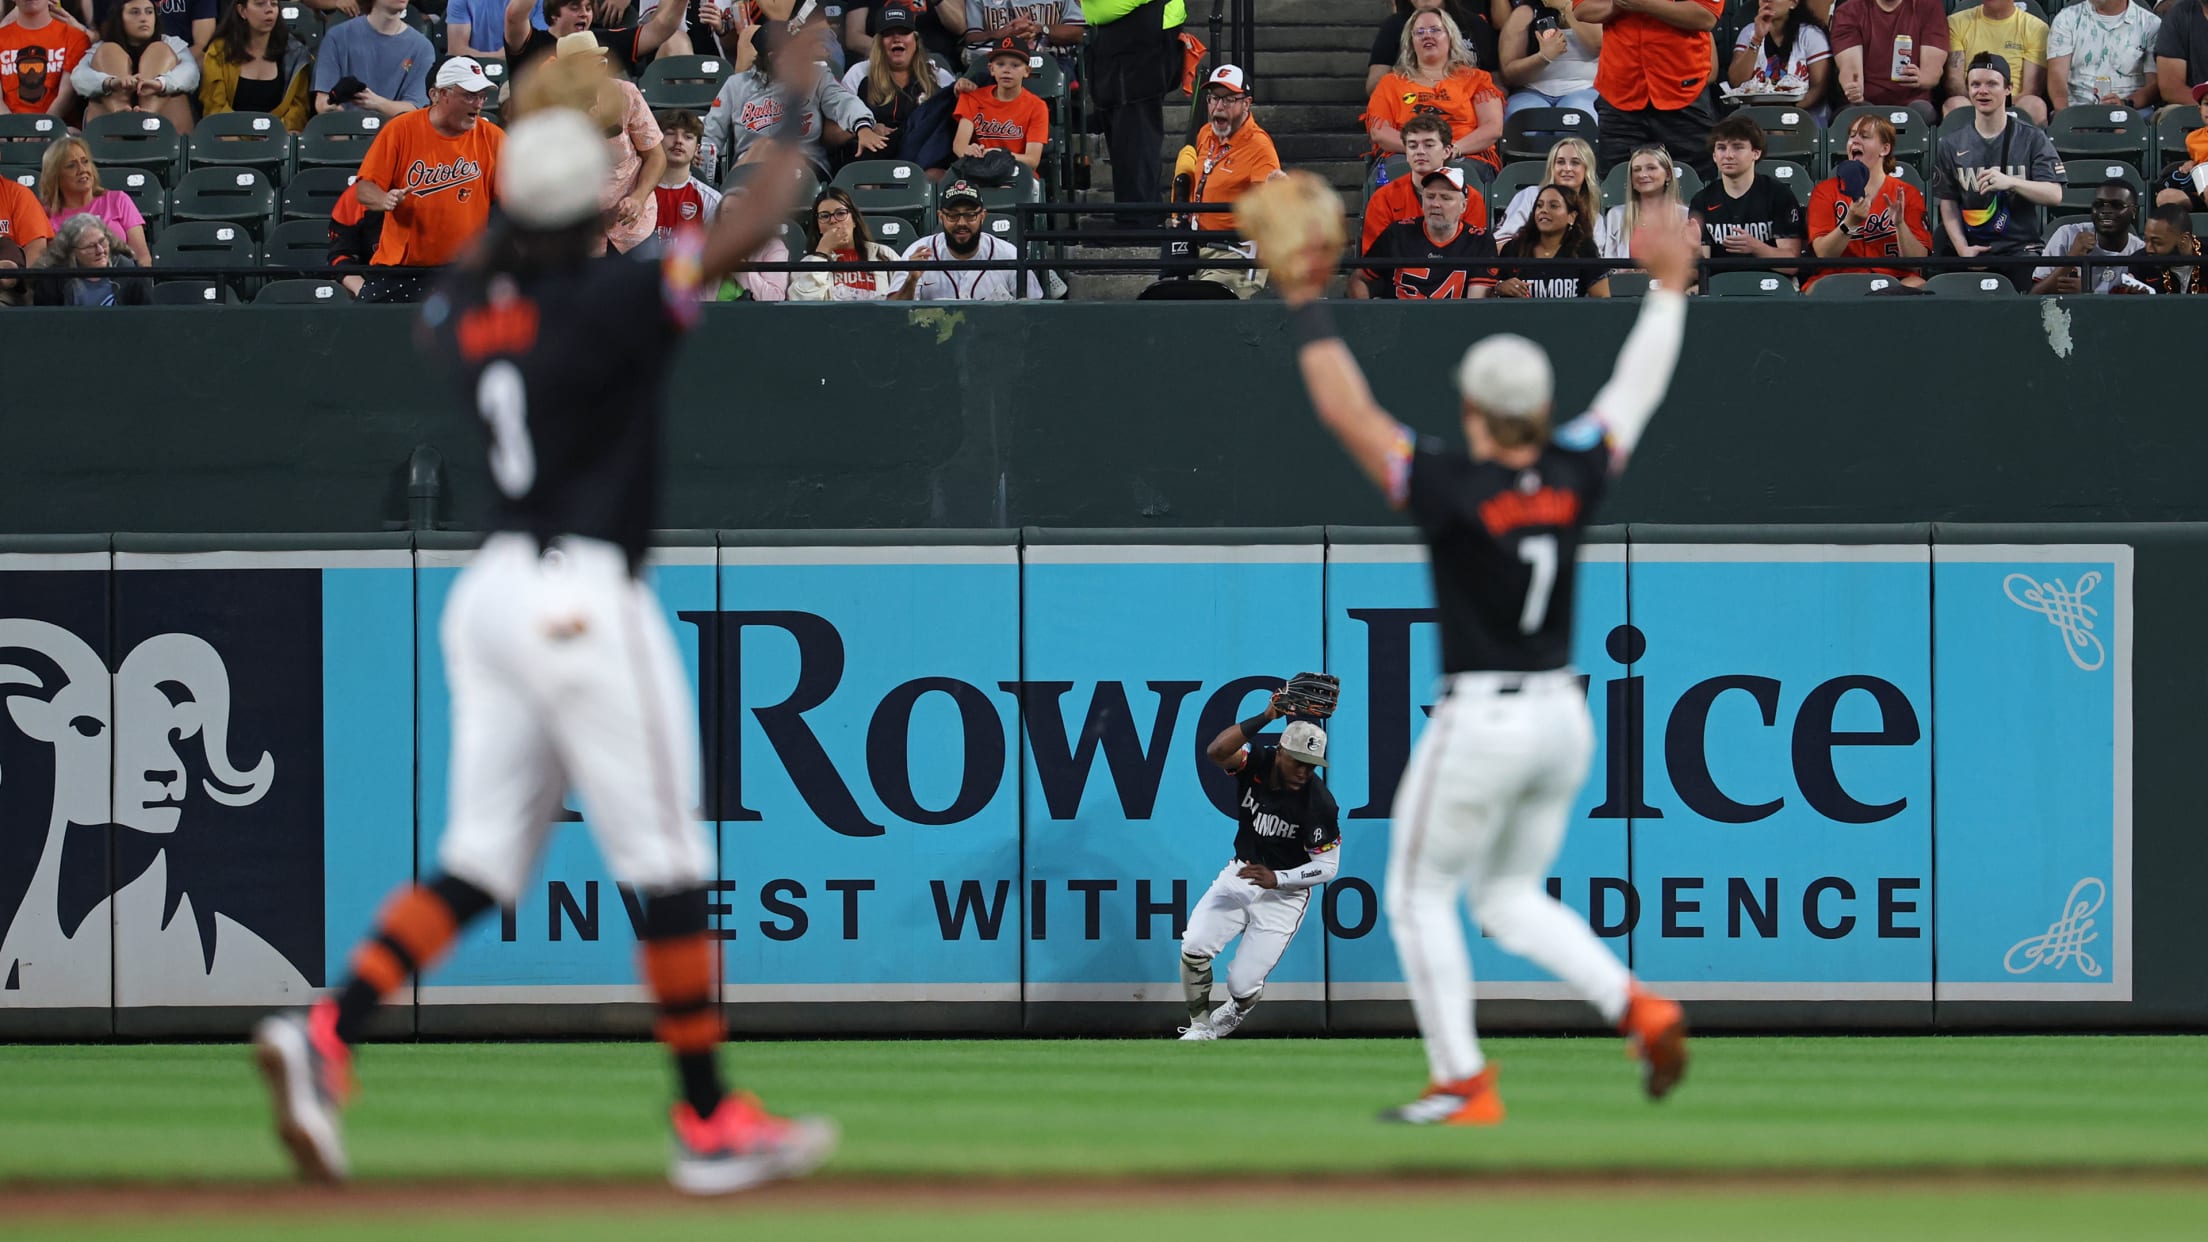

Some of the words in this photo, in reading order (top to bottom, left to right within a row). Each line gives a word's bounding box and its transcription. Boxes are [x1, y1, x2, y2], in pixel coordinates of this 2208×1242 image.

[973, 113, 1023, 140] Orioles
[407, 157, 481, 188] Orioles
[1526, 278, 1579, 298] TIMORE
[1518, 534, 1558, 634] 7
[1313, 827, 1322, 843] B
[929, 880, 1188, 940] WITH
